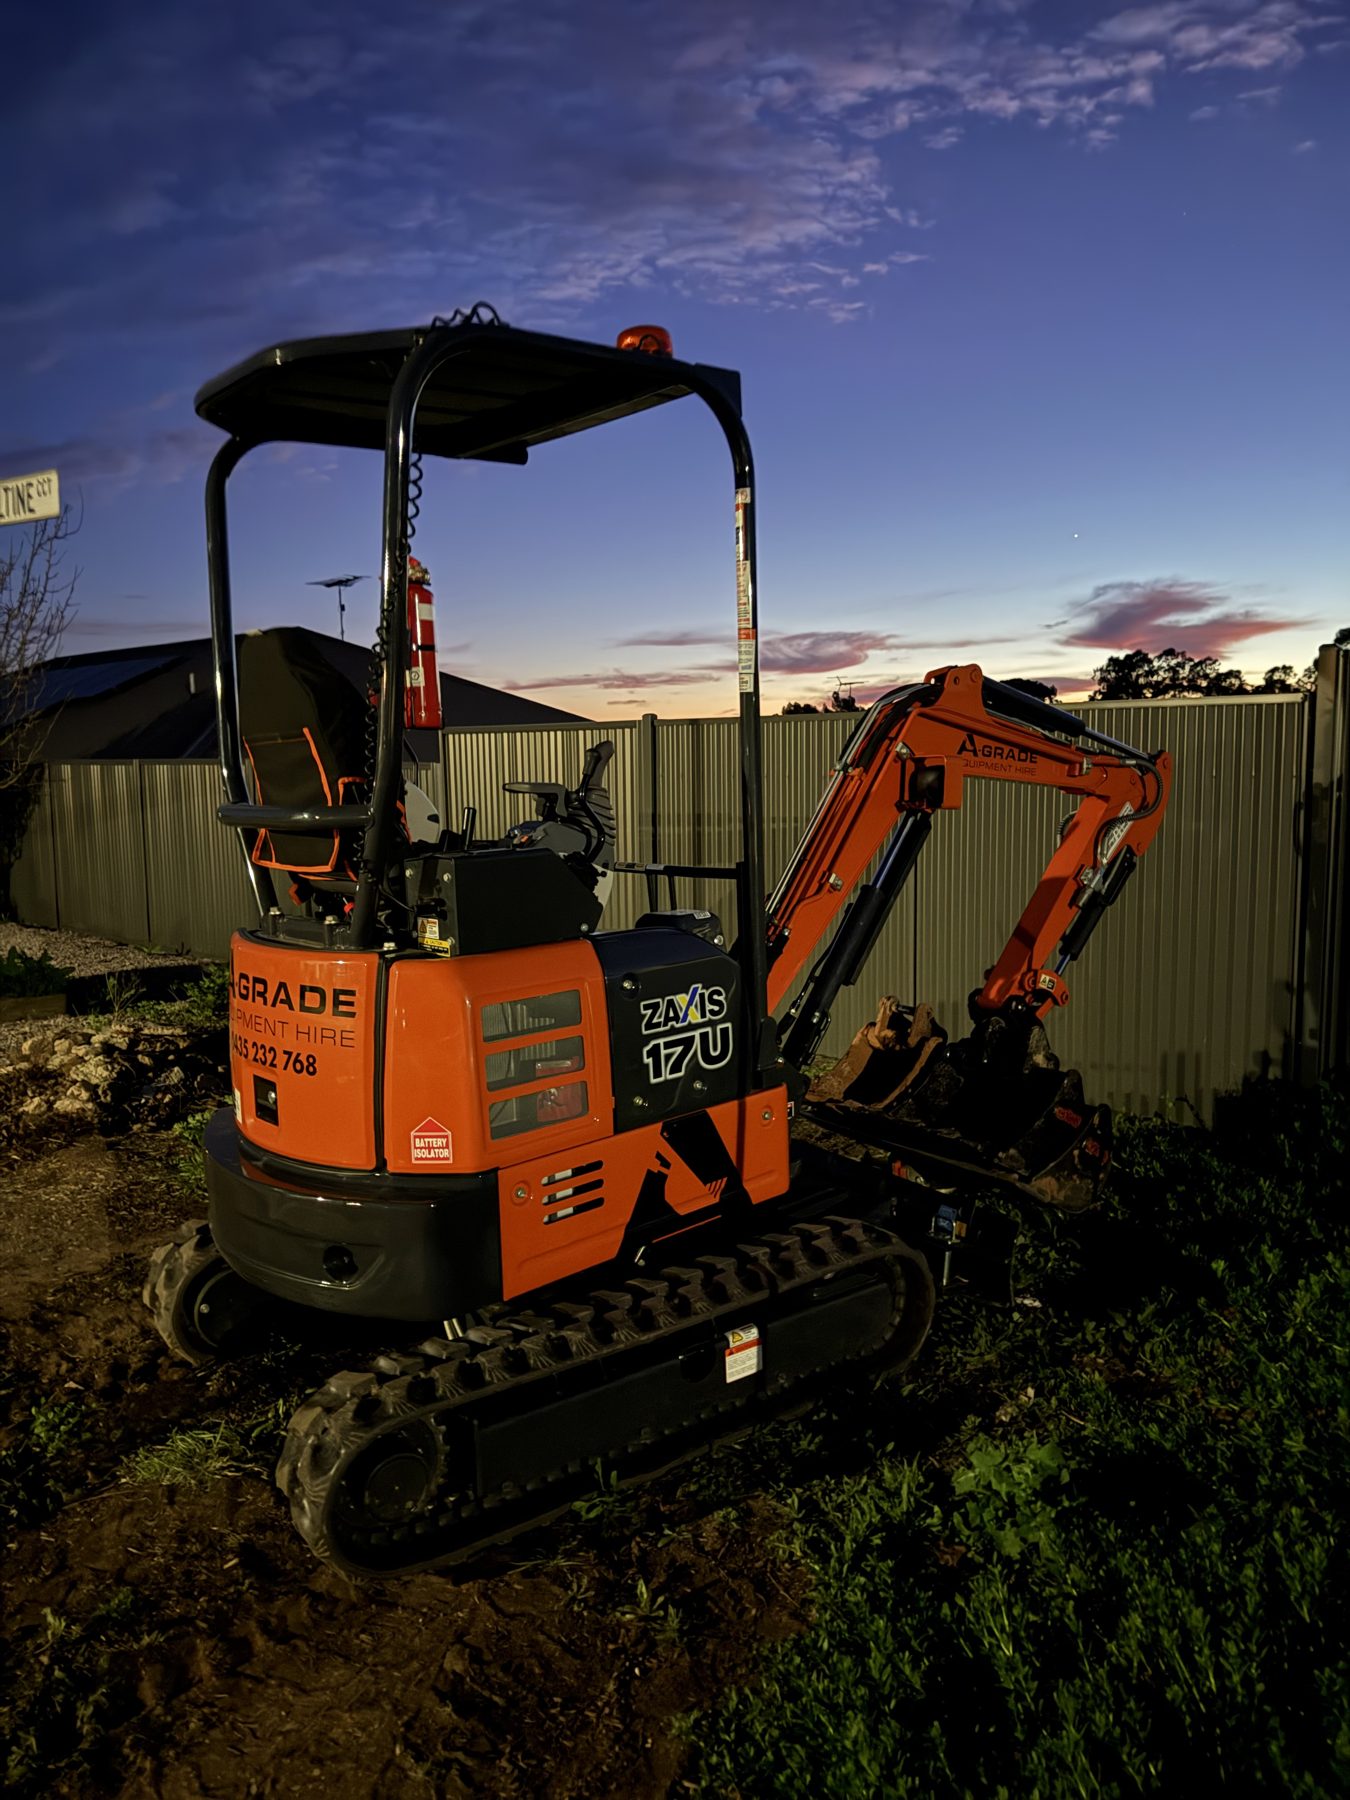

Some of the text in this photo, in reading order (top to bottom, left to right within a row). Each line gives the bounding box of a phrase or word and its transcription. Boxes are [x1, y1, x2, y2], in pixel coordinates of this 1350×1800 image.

[36, 477, 52, 497] CCT
[956, 733, 1038, 764] A-GRADE
[1015, 766, 1037, 776] HIRE
[640, 984, 727, 1035] ZAXIS
[295, 1023, 355, 1048] HIRE
[251, 1041, 278, 1068] 232
[282, 1049, 317, 1076] 768
[643, 1022, 733, 1084] 17U
[414, 1148, 449, 1158] ISOLATOR
[415, 1138, 447, 1147] BATTERY
